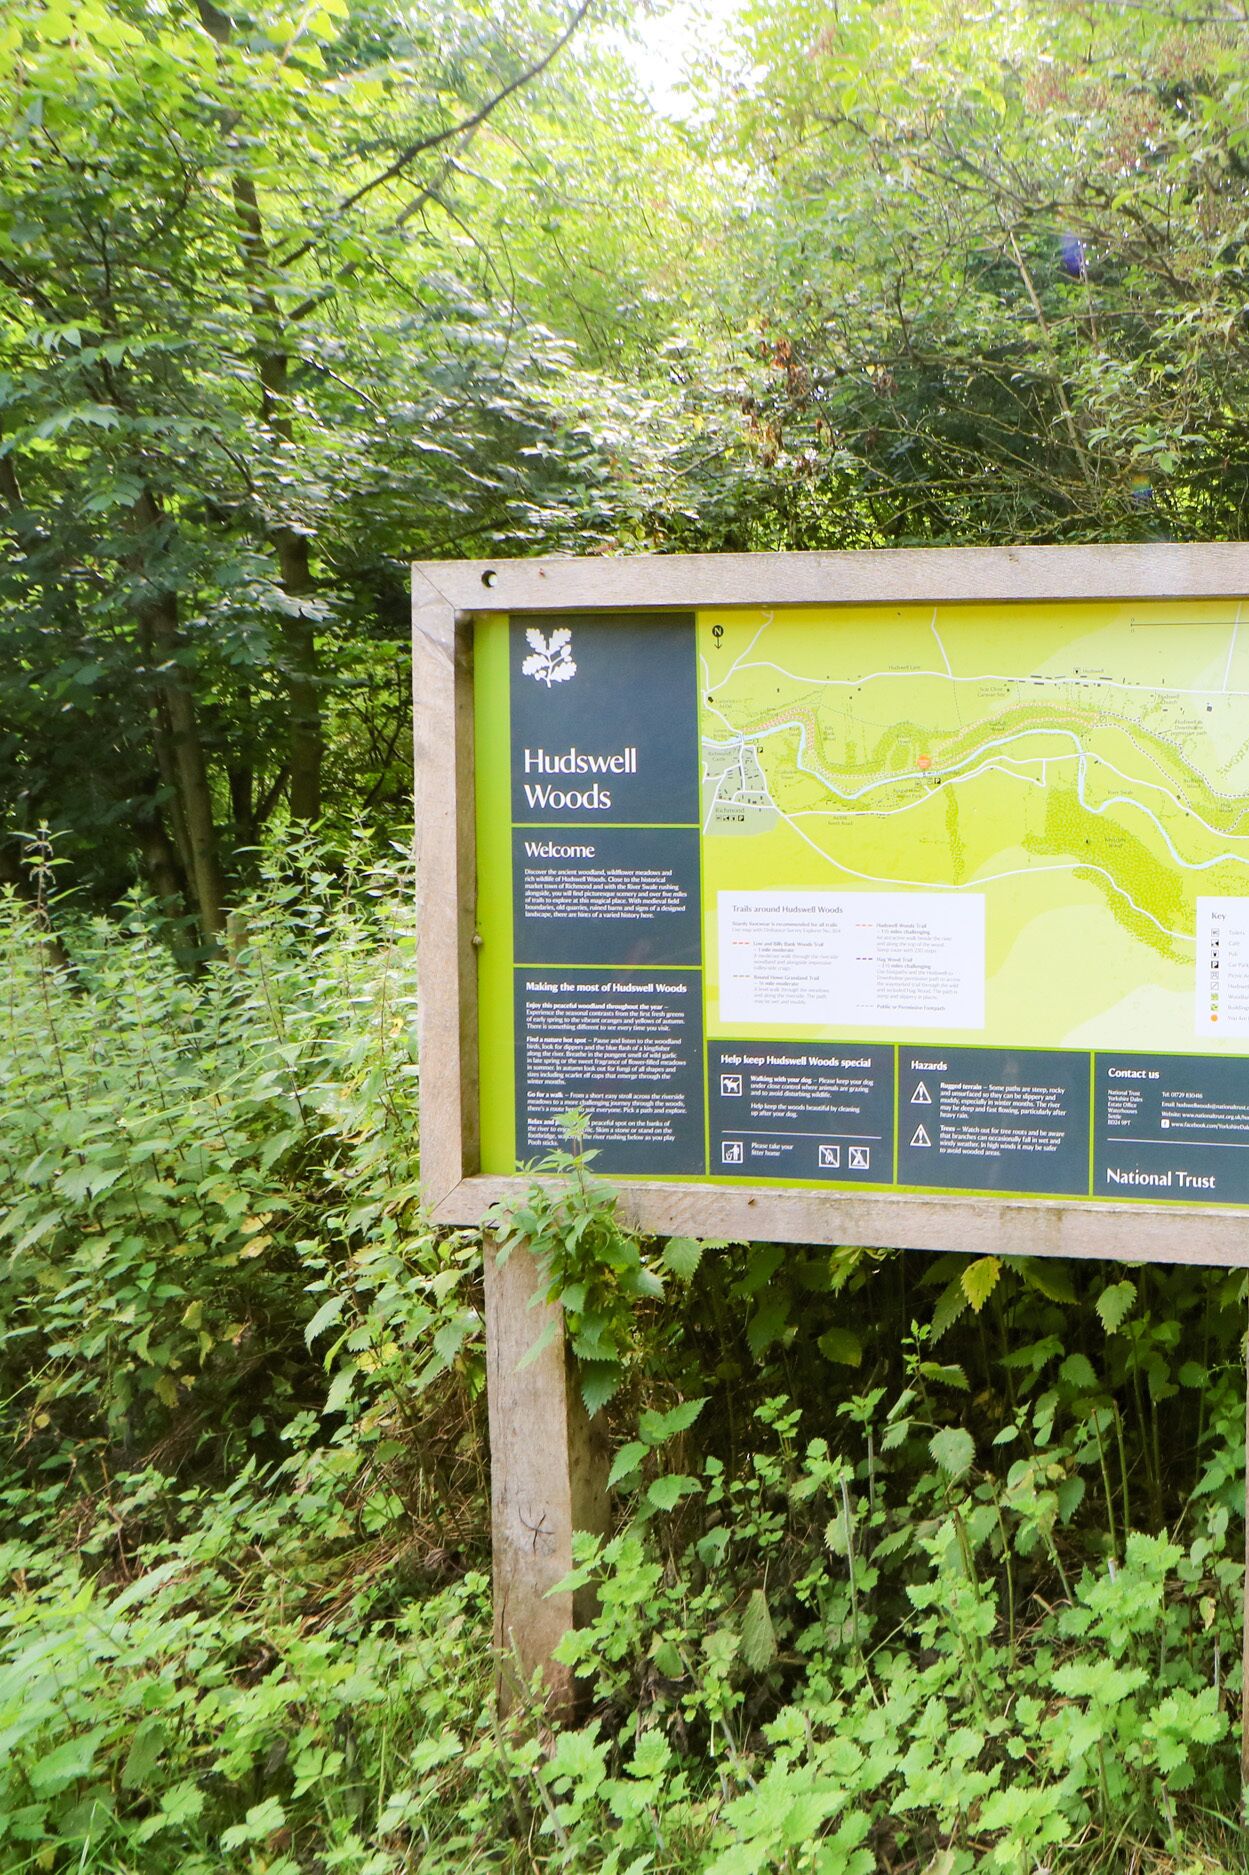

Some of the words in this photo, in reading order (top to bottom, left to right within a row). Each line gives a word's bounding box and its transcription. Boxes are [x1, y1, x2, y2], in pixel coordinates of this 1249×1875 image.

[524, 748, 636, 773] Hudswell
[523, 784, 611, 809] Woods
[525, 842, 595, 858] Welcome
[732, 905, 752, 913] Trails
[782, 906, 816, 914] Hudswell
[817, 906, 843, 914] Woods
[1211, 912, 1226, 920] Key
[526, 982, 558, 993] Making
[560, 983, 575, 992] the
[577, 983, 599, 992] most
[601, 983, 612, 992] of
[612, 983, 653, 992] Hudswell
[655, 984, 687, 993] Woods
[721, 1055, 742, 1065] Help
[743, 1056, 765, 1066] keep
[766, 1056, 807, 1066] Hudswell
[809, 1057, 839, 1066] Woods
[840, 1059, 871, 1068] special
[911, 1061, 947, 1071] Hazards
[1108, 1068, 1146, 1079] Contact
[1148, 1070, 1160, 1079] us
[1107, 1167, 1172, 1187] National
[1176, 1171, 1216, 1189] Trust
